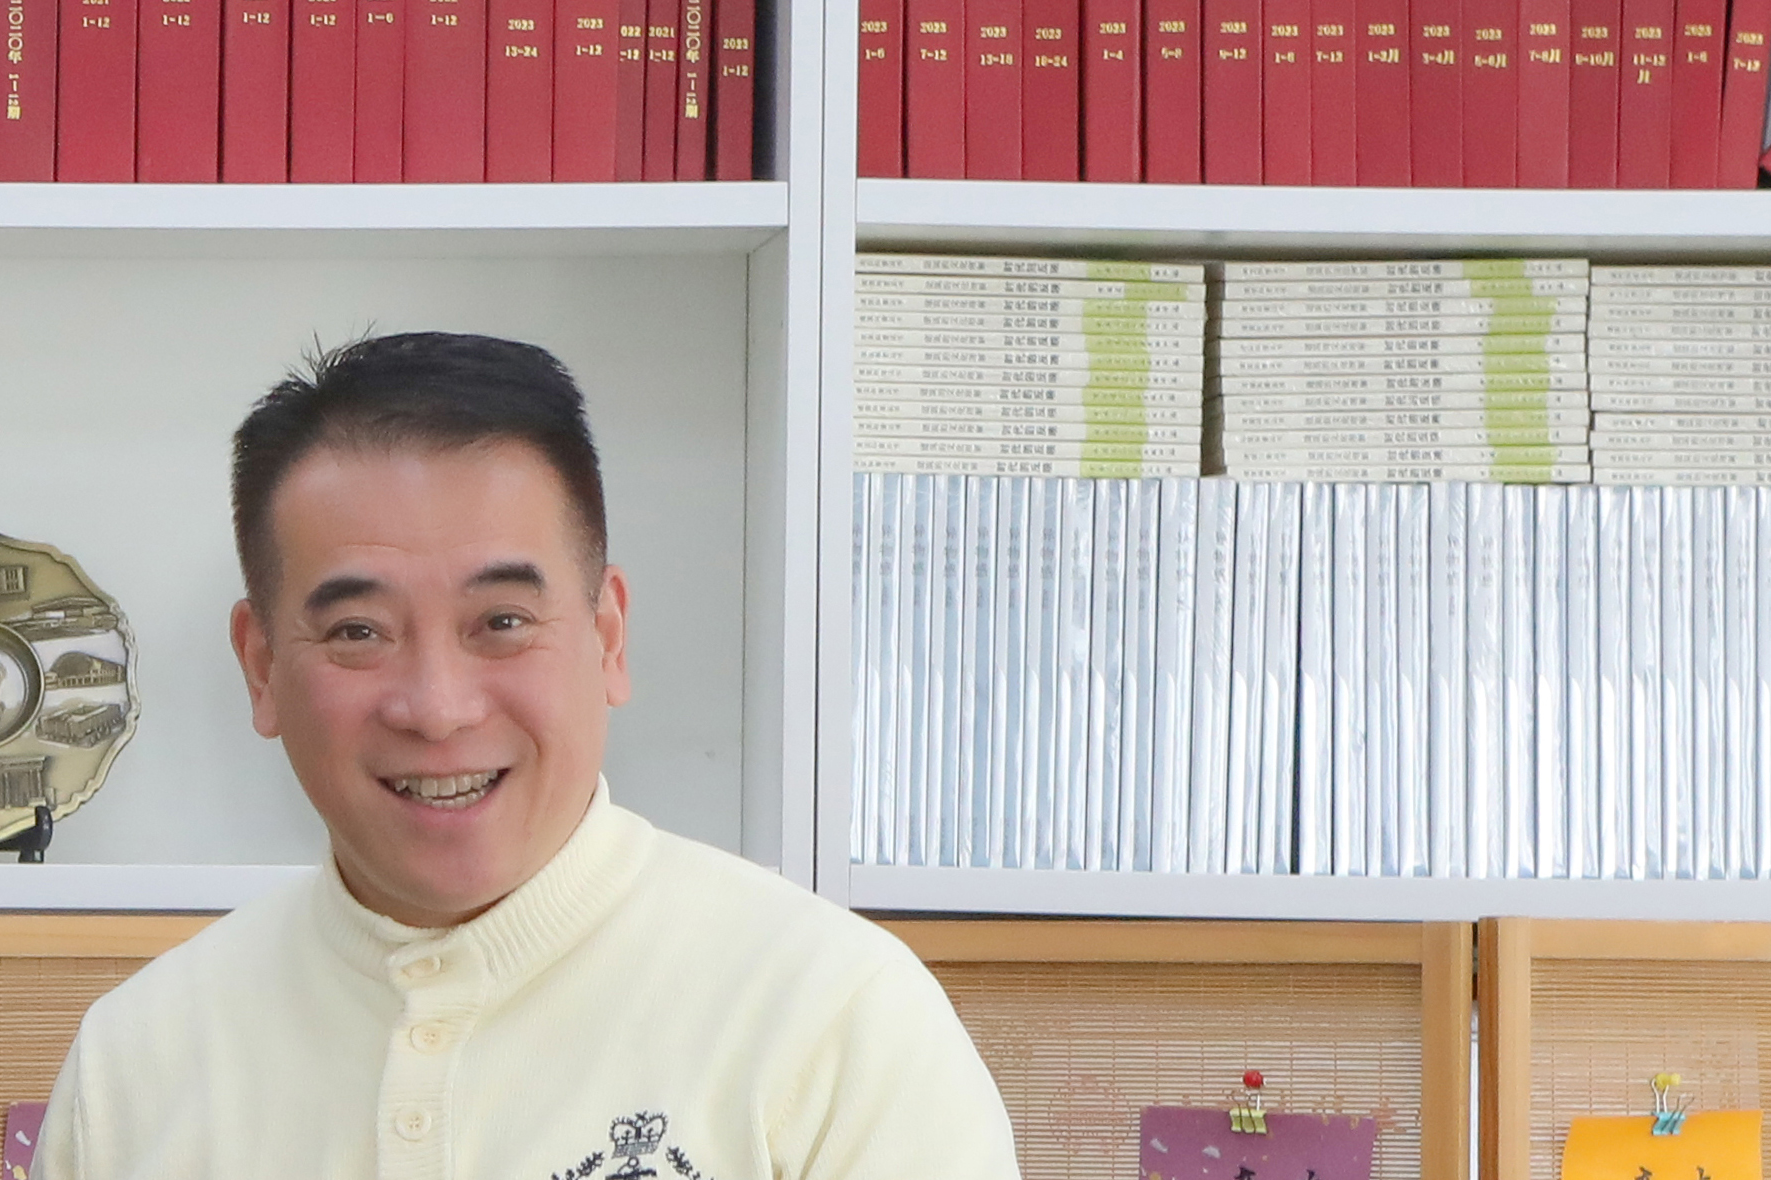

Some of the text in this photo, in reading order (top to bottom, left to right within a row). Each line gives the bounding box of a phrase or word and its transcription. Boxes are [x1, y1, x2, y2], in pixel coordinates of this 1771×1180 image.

[82, 16, 110, 29] 1-12
[162, 14, 190, 26] 1-12
[243, 11, 270, 24] 1-12
[310, 14, 336, 27] 1-12
[431, 14, 458, 26] 1-12
[576, 17, 604, 30] 2023
[507, 18, 535, 31] 2023
[861, 21, 888, 34] 2023
[919, 21, 947, 34] 2023
[1099, 22, 1127, 35] 2023
[1158, 20, 1186, 33] 2023
[1220, 21, 1247, 34] 2023
[1271, 25, 1299, 37] 2023
[1316, 24, 1344, 37] 2023
[1368, 23, 1395, 36] 2023
[1529, 23, 1557, 36] 2023
[1684, 24, 1712, 37] 2023
[620, 25, 642, 38] 022
[648, 26, 675, 39] 2021
[980, 26, 1007, 39] 2023
[1035, 27, 1062, 40] 2023
[1423, 25, 1451, 38] 2023
[1475, 28, 1502, 41] 2023
[1581, 26, 1609, 39] 2023
[1635, 26, 1662, 39] 2023
[1735, 32, 1764, 46] 2023
[505, 45, 538, 58] 13-24
[576, 44, 603, 57] 1-12
[920, 48, 948, 61] 7-12
[722, 65, 749, 77] 1-12
